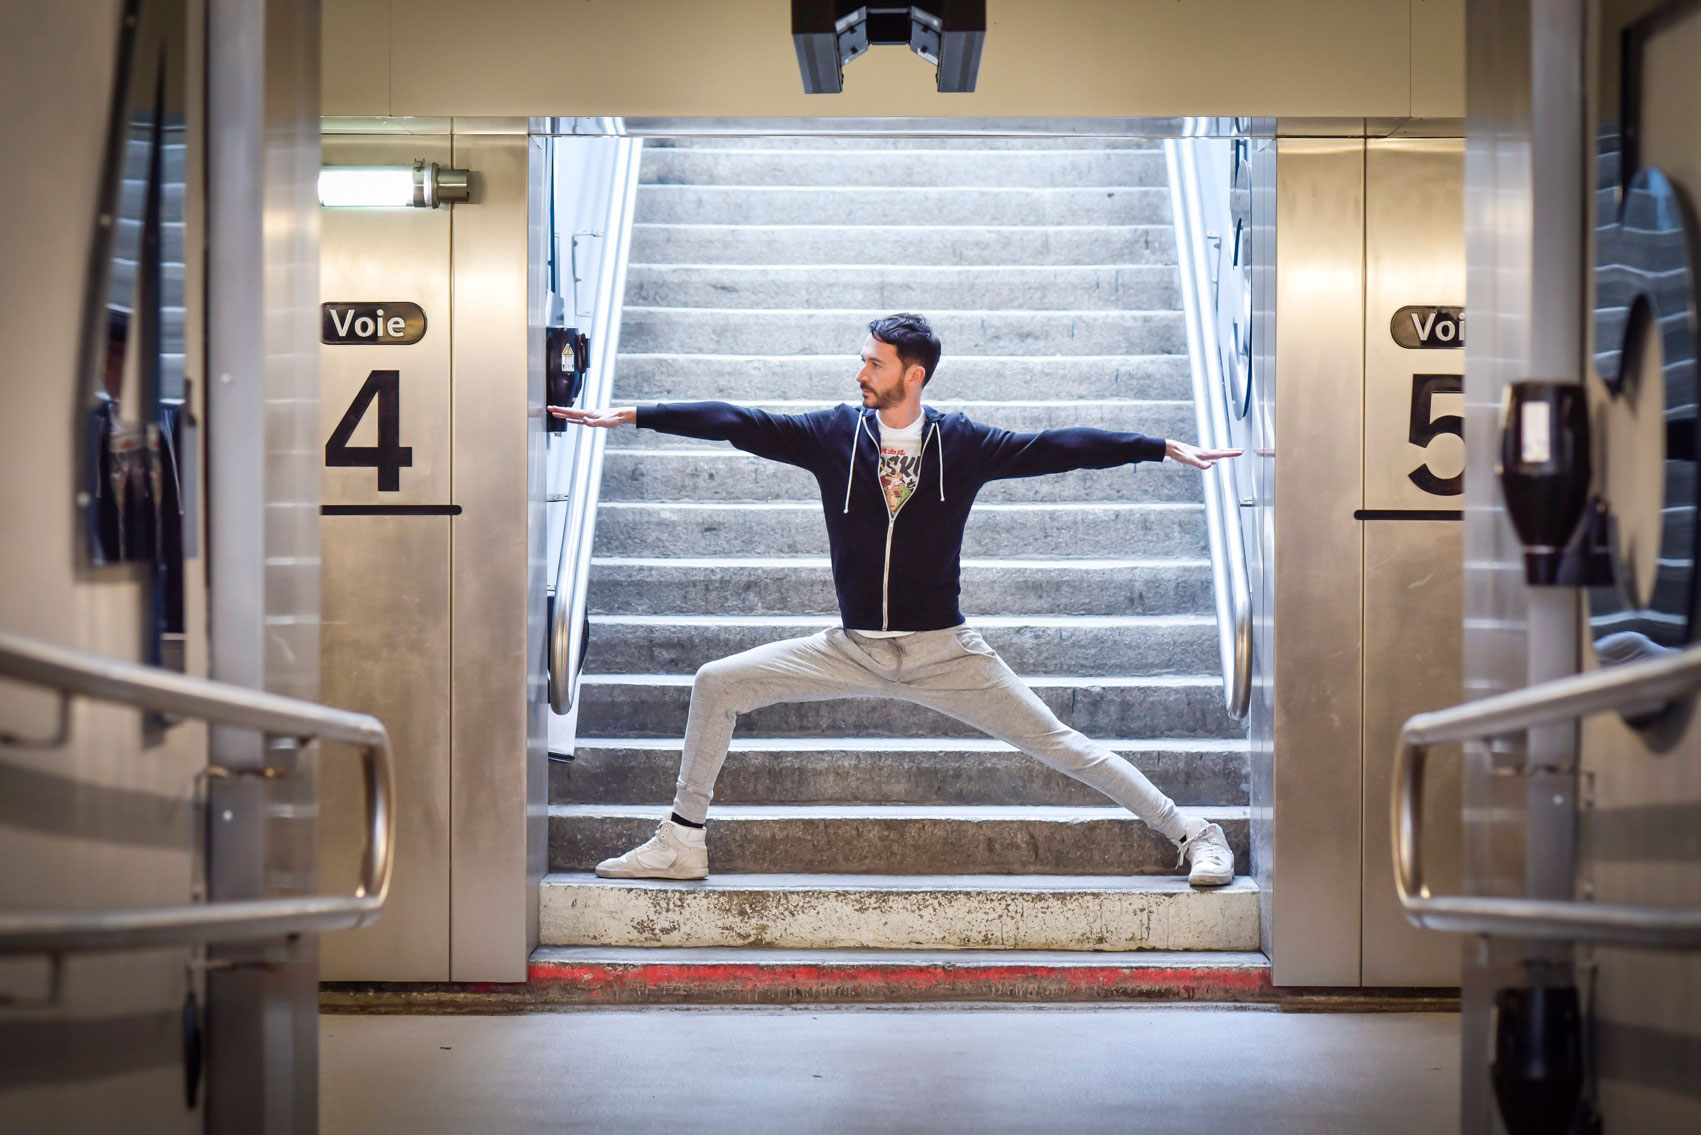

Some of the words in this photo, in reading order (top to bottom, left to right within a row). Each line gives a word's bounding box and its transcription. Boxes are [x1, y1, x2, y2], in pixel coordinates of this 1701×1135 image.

[329, 308, 406, 338] Voie
[325, 370, 413, 492] 4
[1408, 373, 1466, 497] 5
